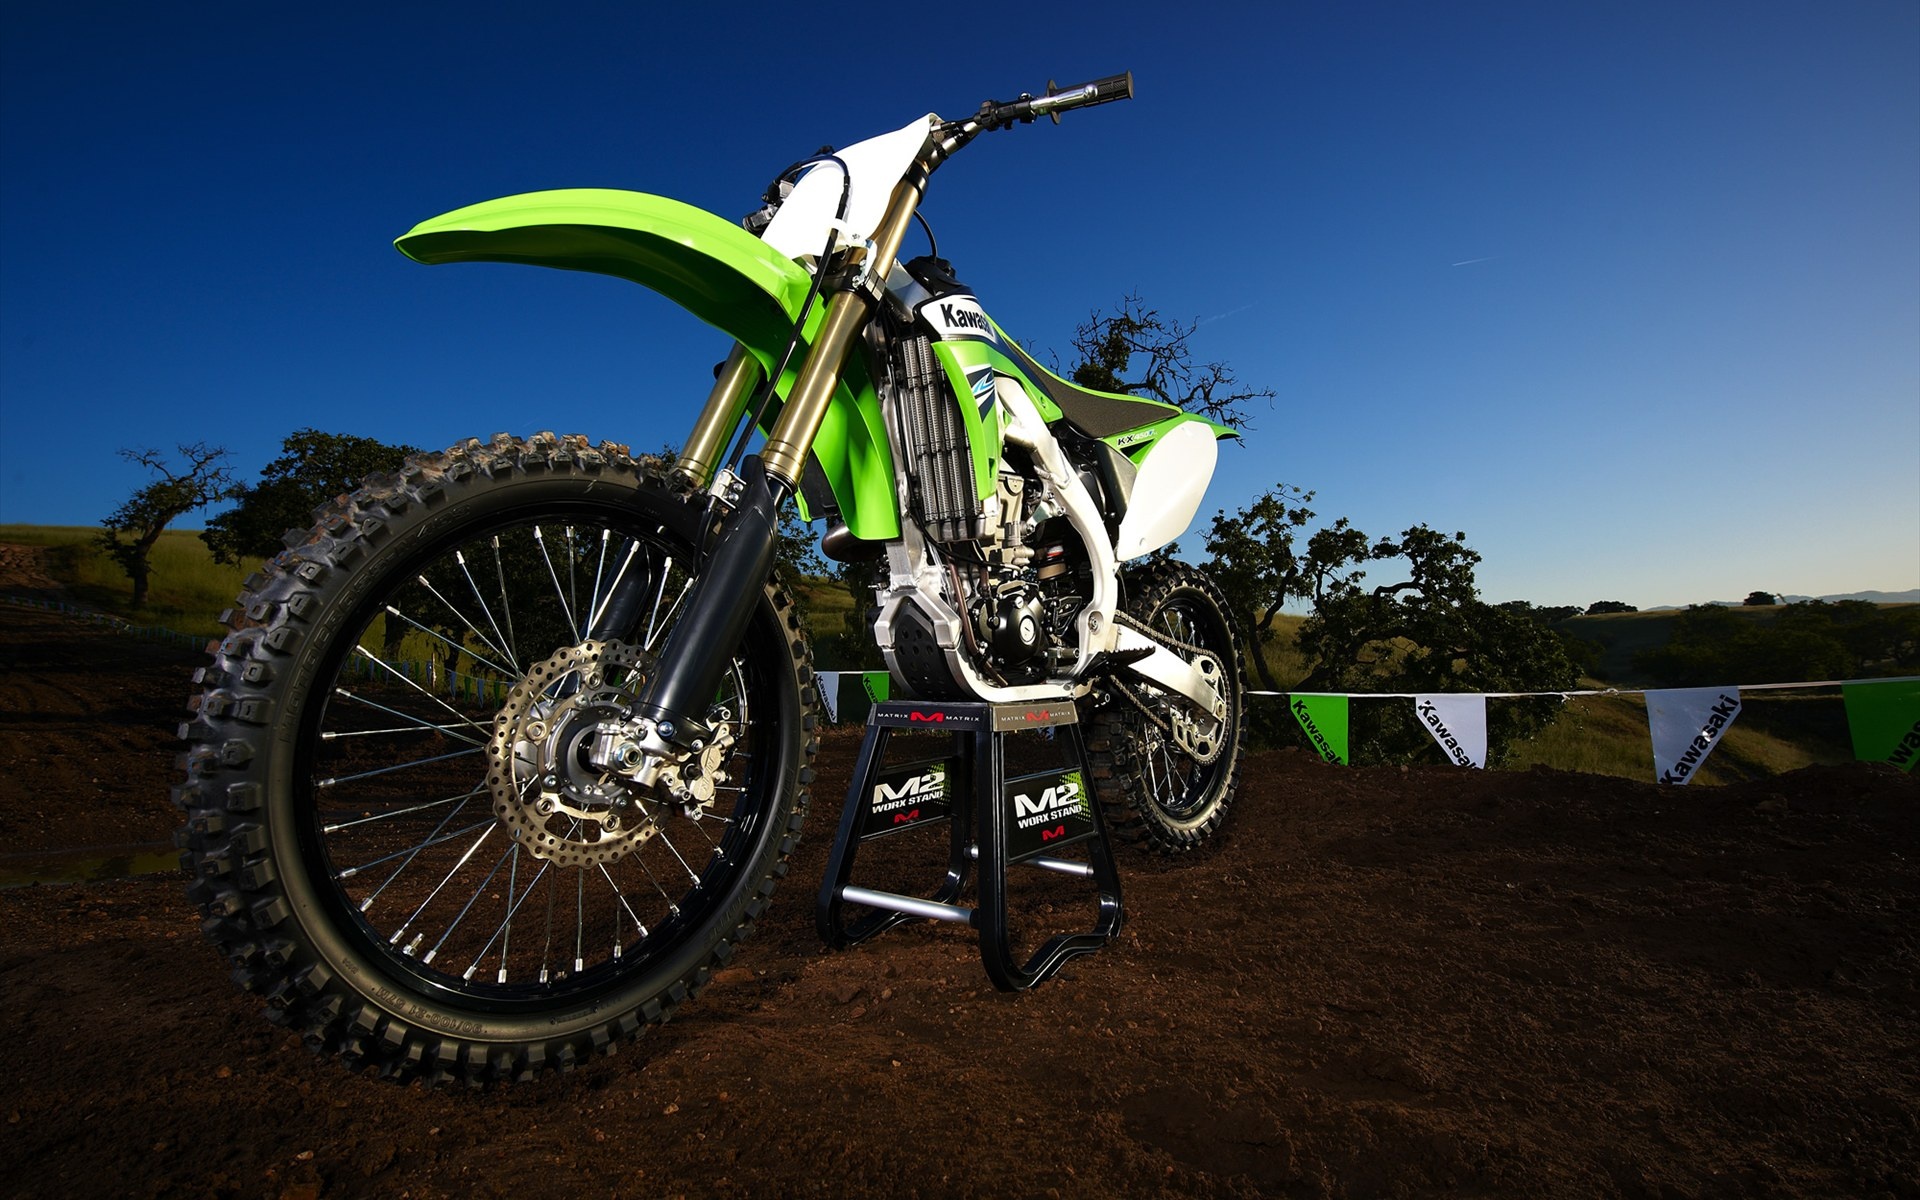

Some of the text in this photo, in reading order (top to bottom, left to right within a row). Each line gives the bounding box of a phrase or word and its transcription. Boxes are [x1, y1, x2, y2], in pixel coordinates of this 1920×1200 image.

[817, 675, 837, 721] Kawasaki
[1660, 694, 1739, 784] Kawasaki
[872, 772, 945, 804] M2
[872, 790, 944, 814] WORX STAND
[1014, 782, 1080, 818] M2
[1018, 805, 1082, 829] WORX STAND
